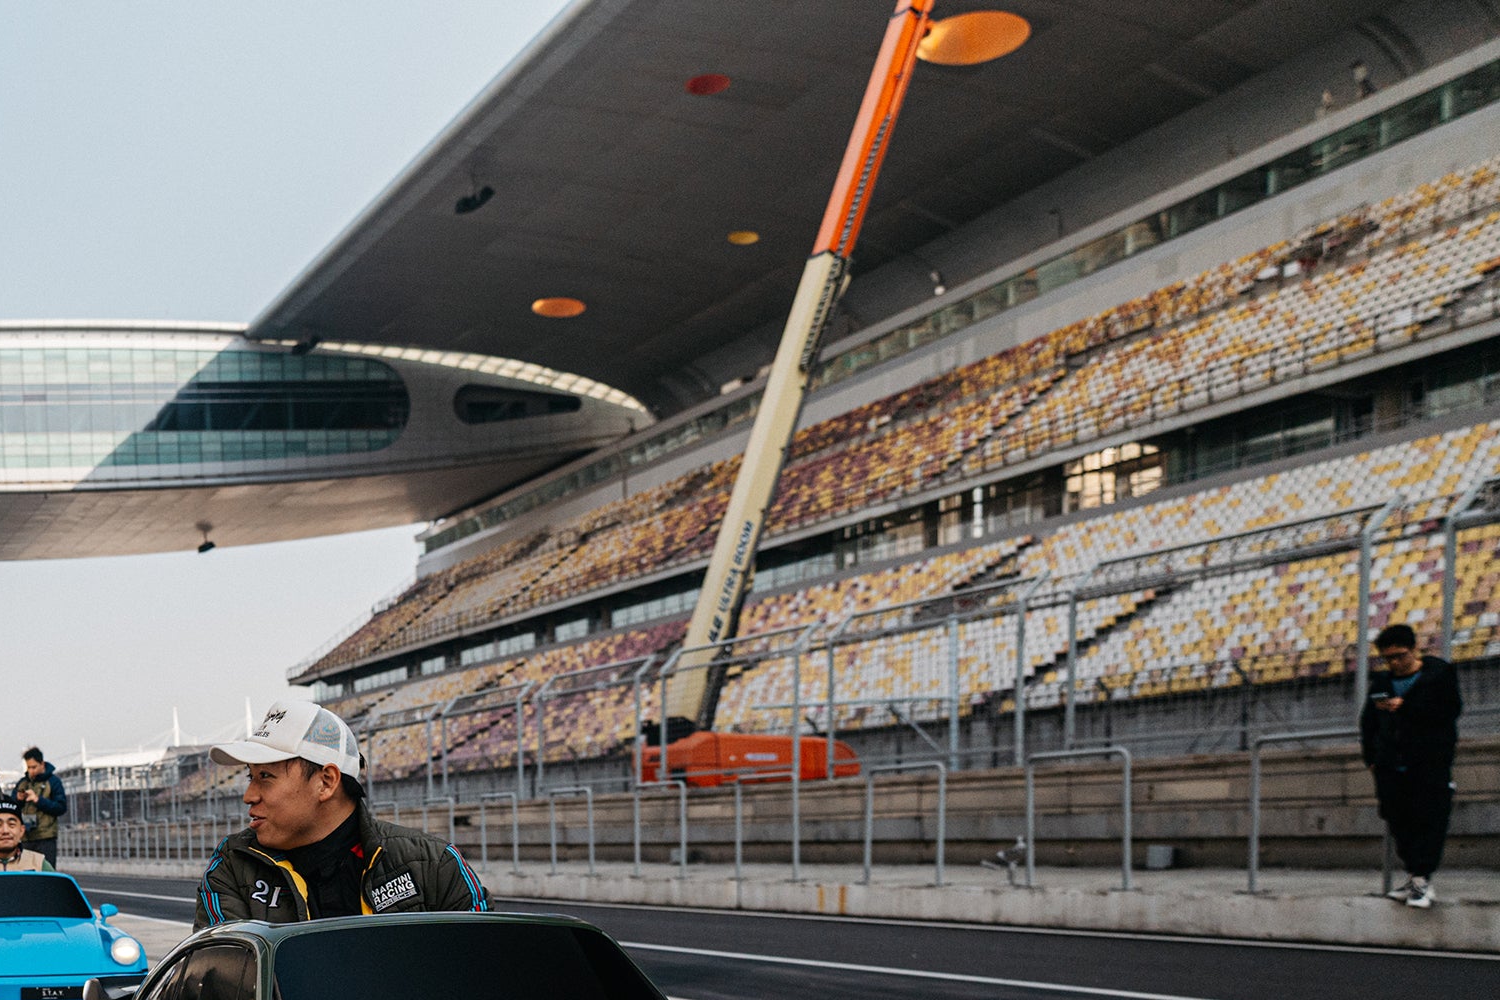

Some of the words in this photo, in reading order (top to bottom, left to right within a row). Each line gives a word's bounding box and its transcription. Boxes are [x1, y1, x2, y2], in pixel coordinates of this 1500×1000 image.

[734, 520, 754, 566] BOOM
[252, 879, 281, 907] 21
[372, 872, 411, 897] MARTINI
[373, 881, 414, 905] RACING
